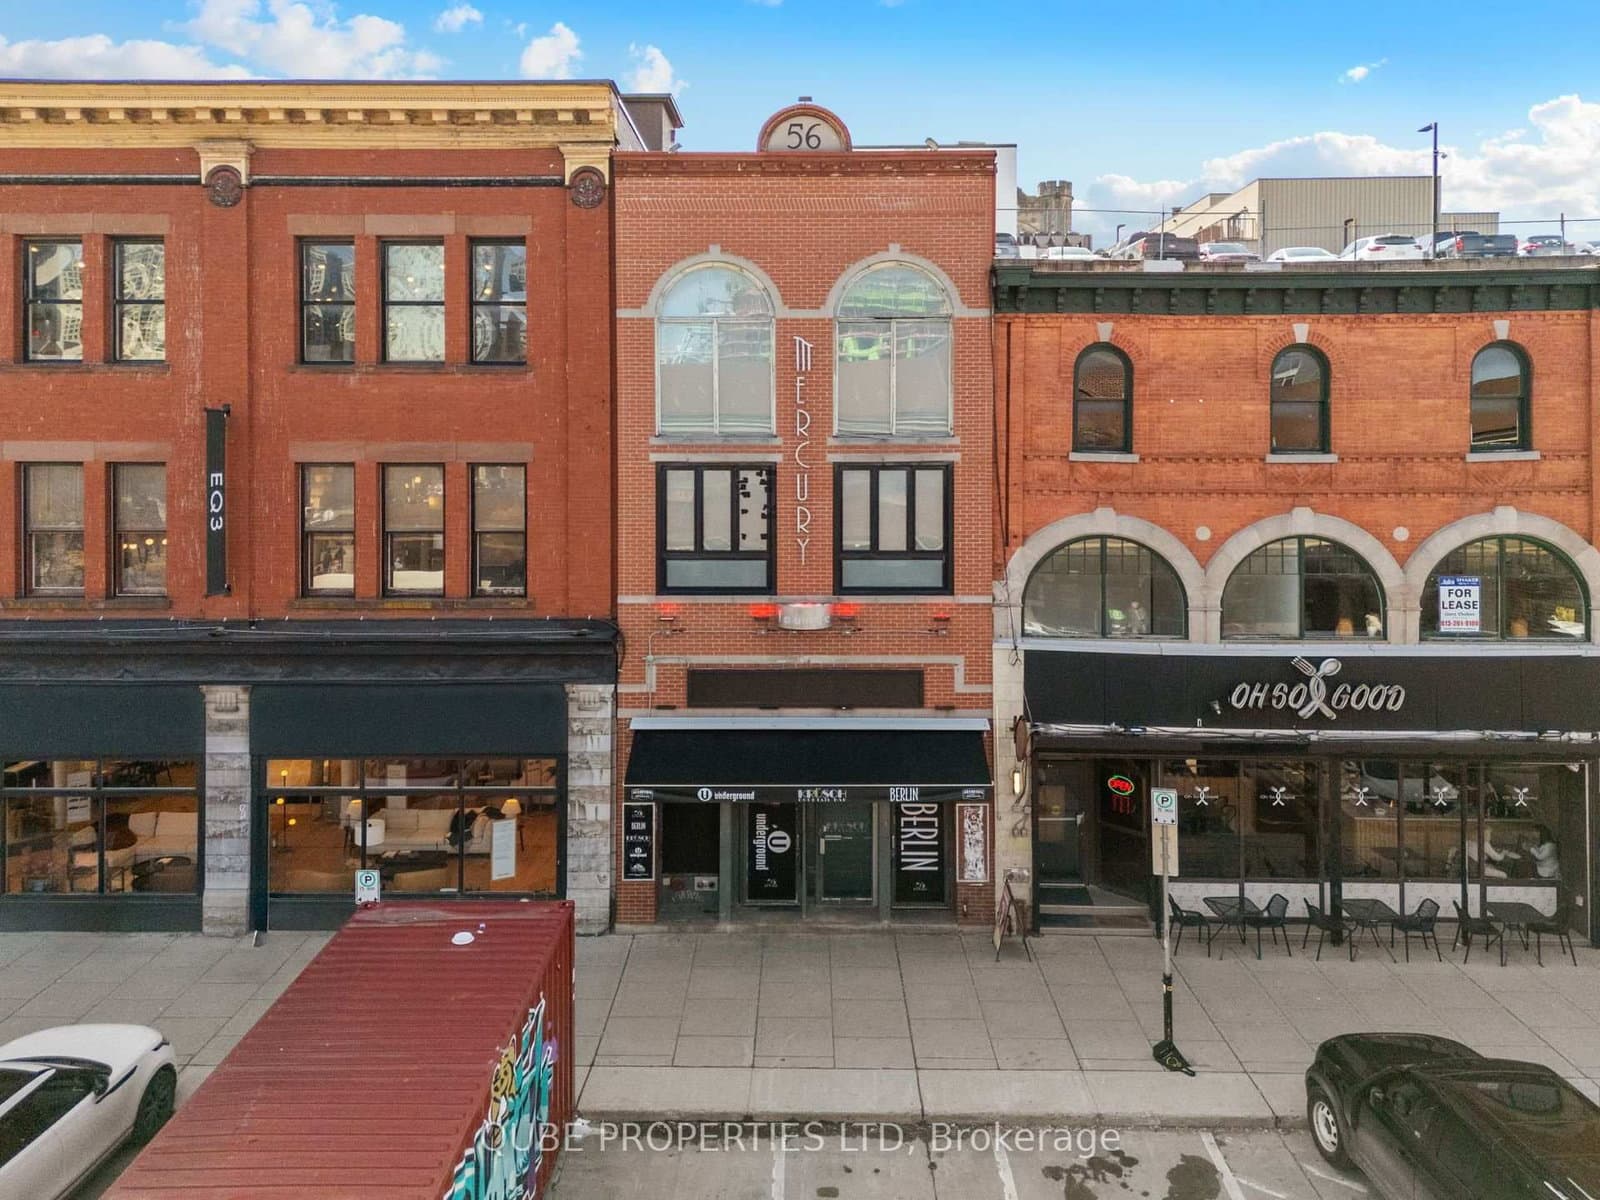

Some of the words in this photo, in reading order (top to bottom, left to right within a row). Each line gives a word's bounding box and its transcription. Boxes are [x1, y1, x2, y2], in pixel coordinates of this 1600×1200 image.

[787, 123, 821, 149] 56
[793, 335, 814, 566] MERCURY
[210, 472, 223, 531] EQ3
[1448, 588, 1472, 598] FOR
[1441, 600, 1479, 610] LEASE
[1231, 682, 1270, 710] OH
[1272, 682, 1308, 710] SO
[1331, 683, 1406, 711] GOOD
[714, 790, 755, 801] underground
[889, 787, 919, 801] BERLIN
[1161, 796, 1169, 804] P
[753, 813, 769, 871] underground
[901, 803, 938, 871] BERLIN
[364, 875, 372, 884] P
